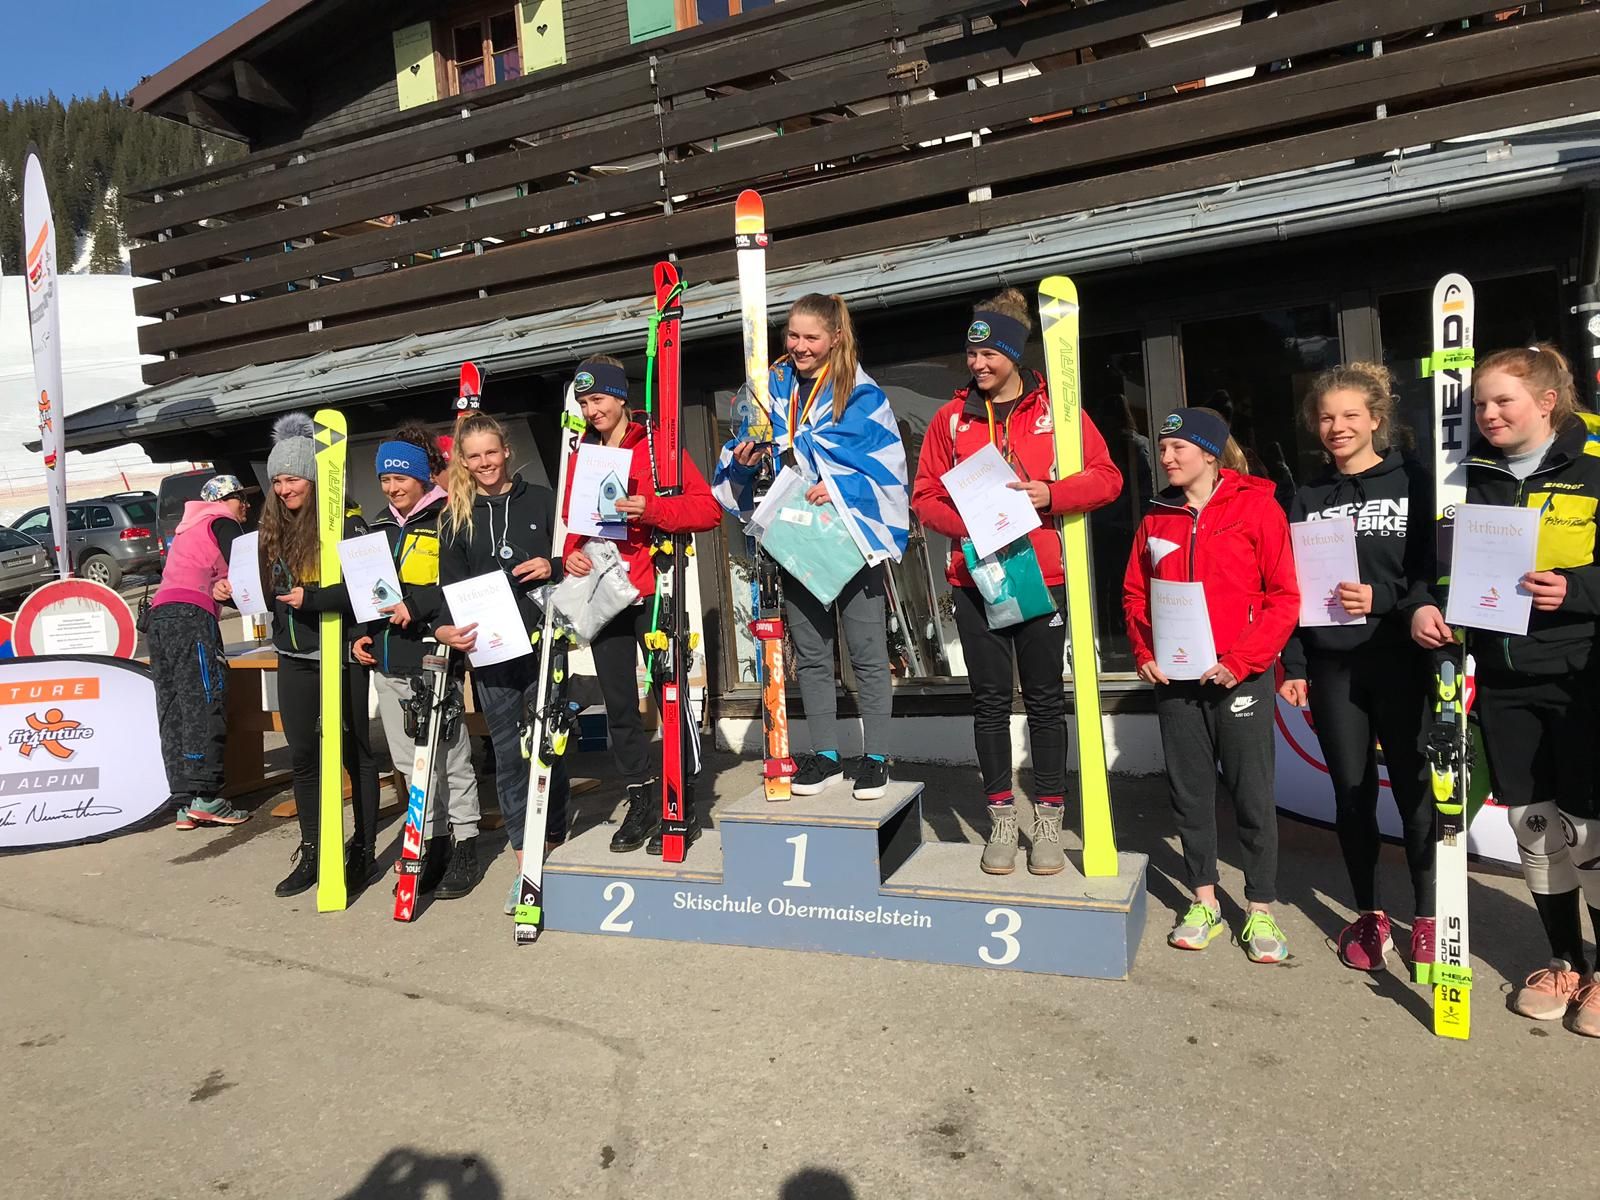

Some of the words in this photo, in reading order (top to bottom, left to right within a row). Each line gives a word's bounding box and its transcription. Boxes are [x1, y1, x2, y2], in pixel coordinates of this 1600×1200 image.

[1059, 337, 1077, 407] CURV
[329, 460, 341, 520] CURV
[1302, 533, 1346, 546] Urkunde
[1357, 516, 1408, 532] BIKE
[1467, 520, 1524, 537] Urkunde
[8, 728, 94, 749] fit4future
[17, 774, 85, 790] ALPIN
[782, 833, 812, 888] 1
[600, 881, 636, 933] 2
[672, 891, 762, 915] Skischule
[767, 897, 932, 929] Obermaiselstein
[978, 908, 1022, 966] 3
